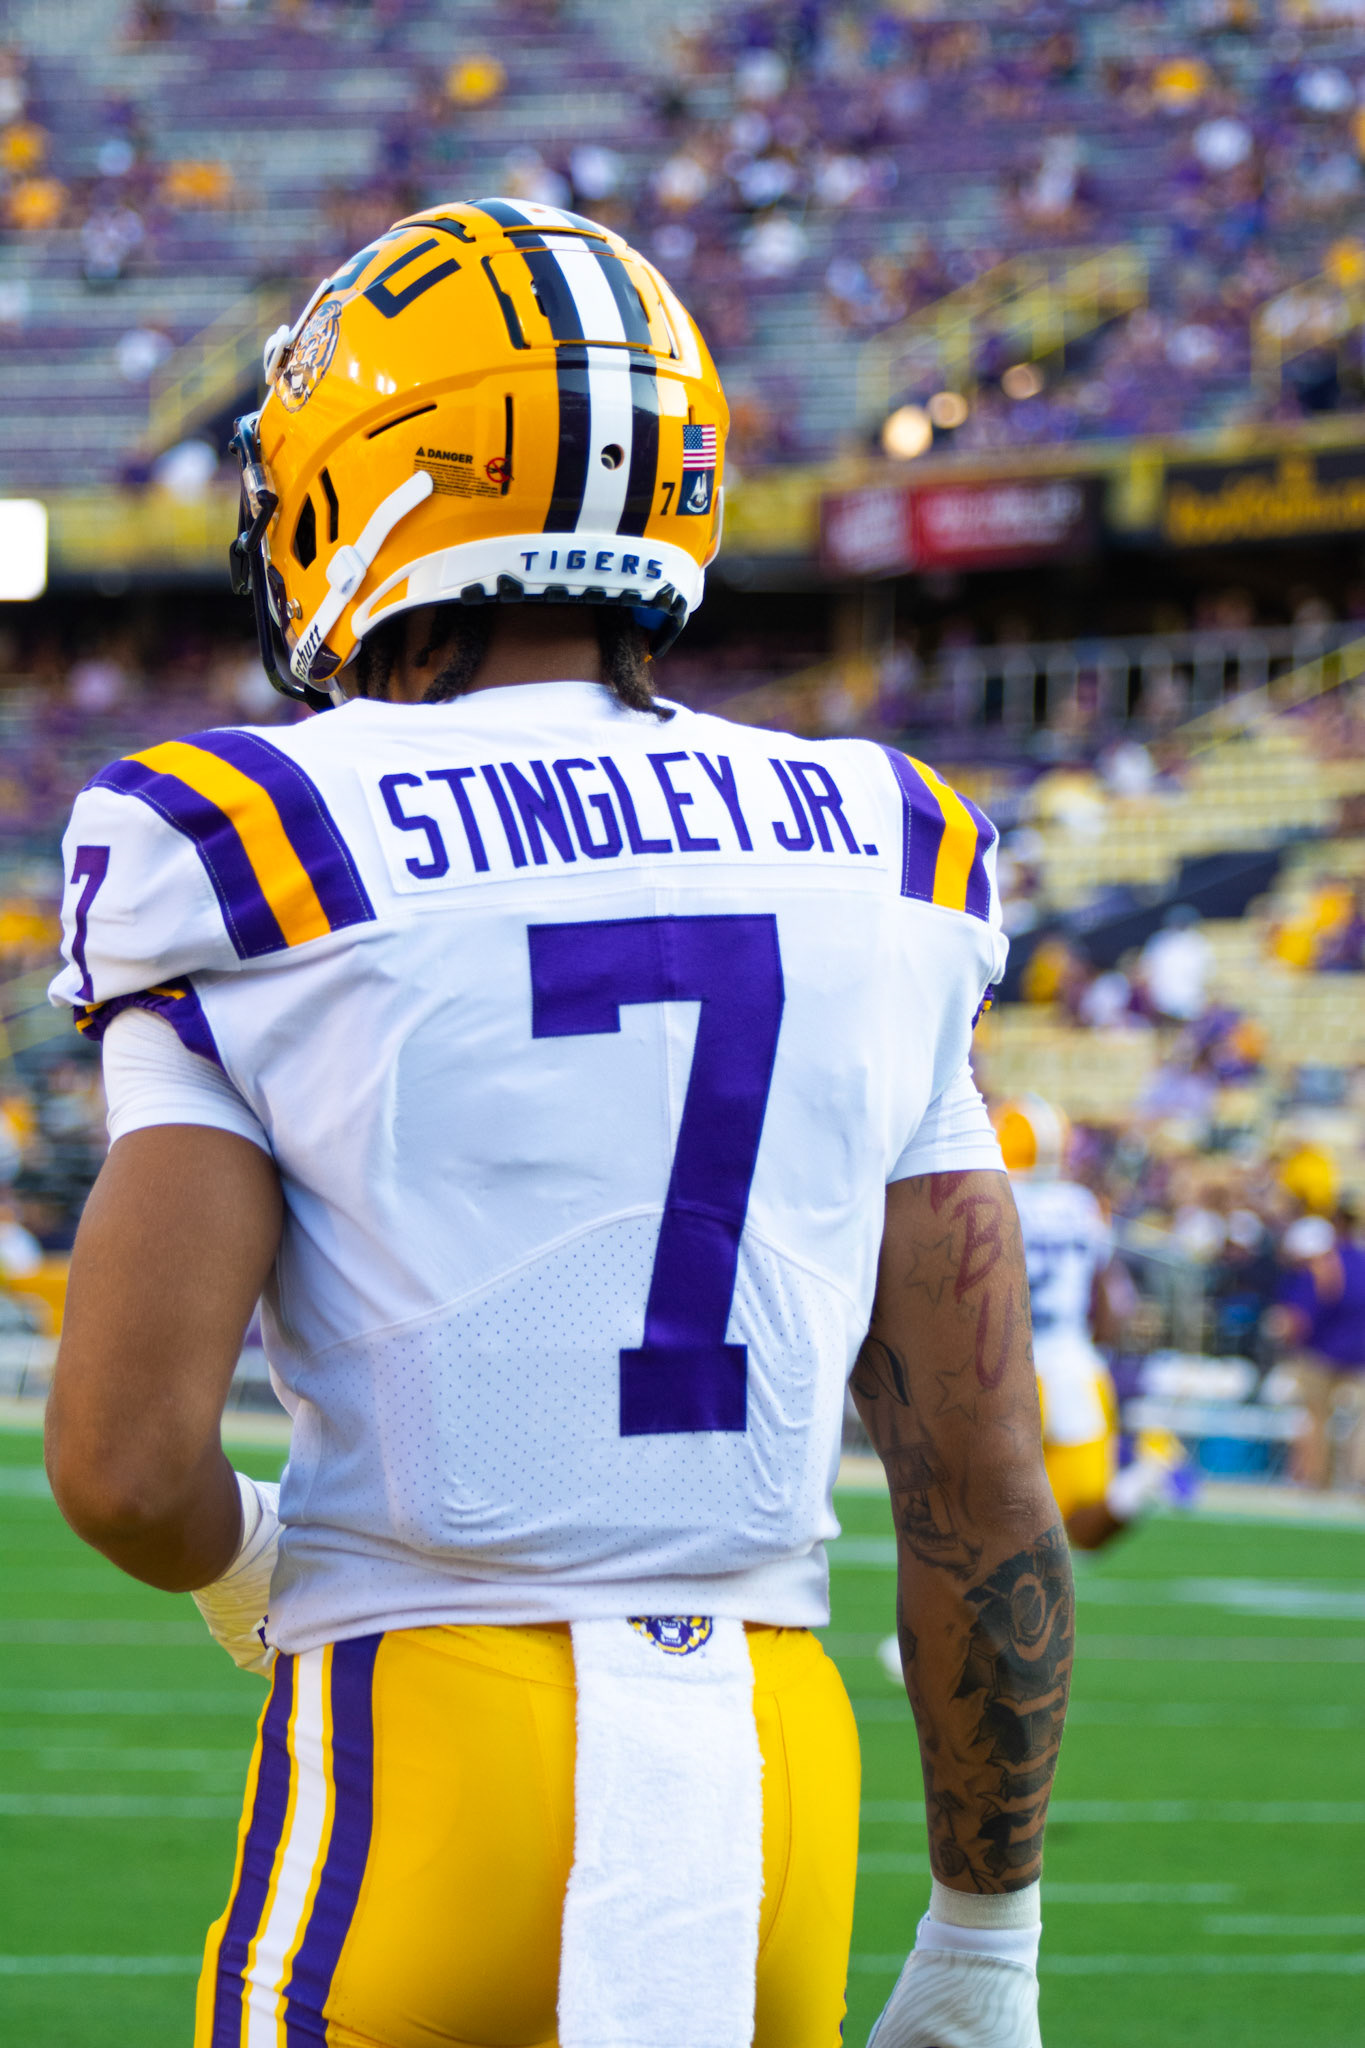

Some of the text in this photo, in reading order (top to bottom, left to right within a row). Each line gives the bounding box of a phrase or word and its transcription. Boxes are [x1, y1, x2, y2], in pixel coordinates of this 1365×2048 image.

[427, 448, 474, 465] DANGER
[660, 482, 676, 516] 7
[520, 549, 664, 580] TIGERS
[378, 751, 879, 880] STINGLEY JR.
[70, 845, 111, 1004] 7
[527, 913, 786, 1437] 7
